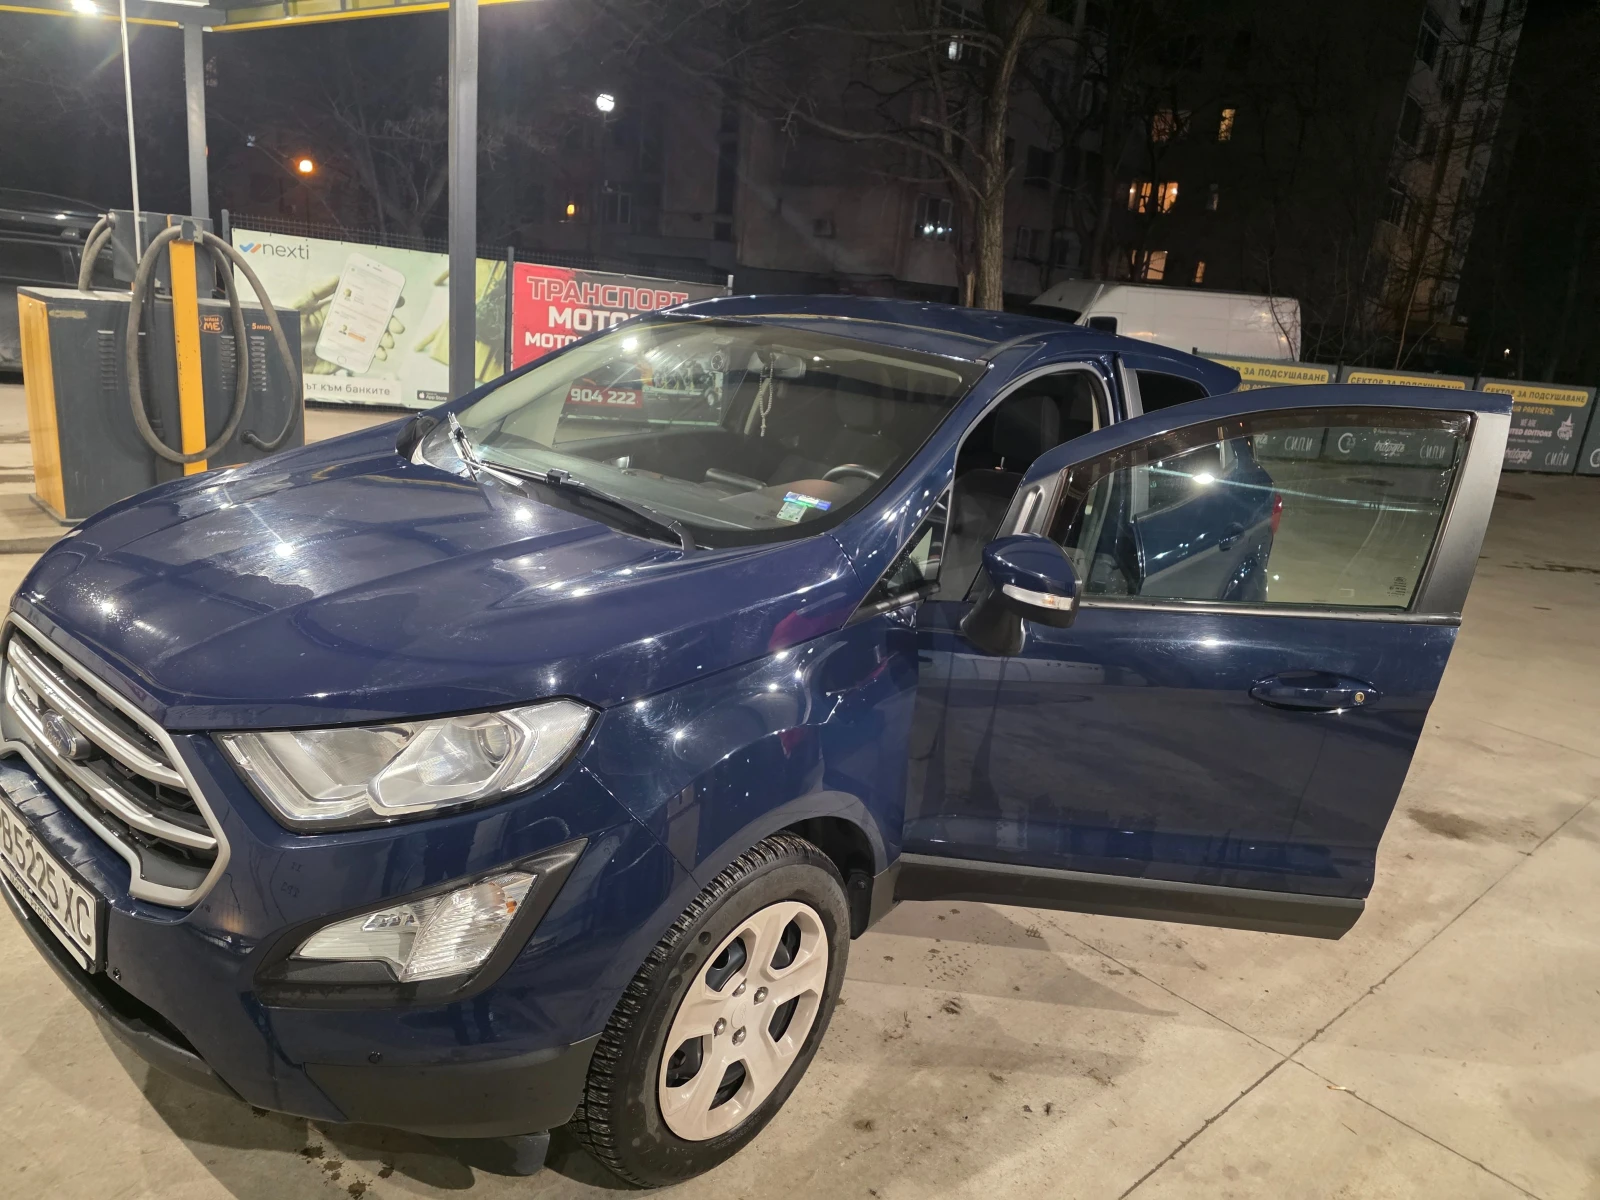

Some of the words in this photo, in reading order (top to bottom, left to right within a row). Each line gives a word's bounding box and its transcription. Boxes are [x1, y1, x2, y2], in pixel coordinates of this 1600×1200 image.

[262, 242, 310, 260] nexti
[526, 276, 689, 312] ТРАНСПОРТ
[548, 306, 638, 332] МОТО
[1243, 367, 1255, 376] ЗА
[1258, 368, 1327, 382] ПОДСУШАВАНЕ
[320, 383, 342, 392] към
[345, 383, 391, 396] банките
[571, 388, 603, 402] 904
[607, 391, 636, 405] 222
[1529, 391, 1587, 403] ПОДСУШАВАНЕ
